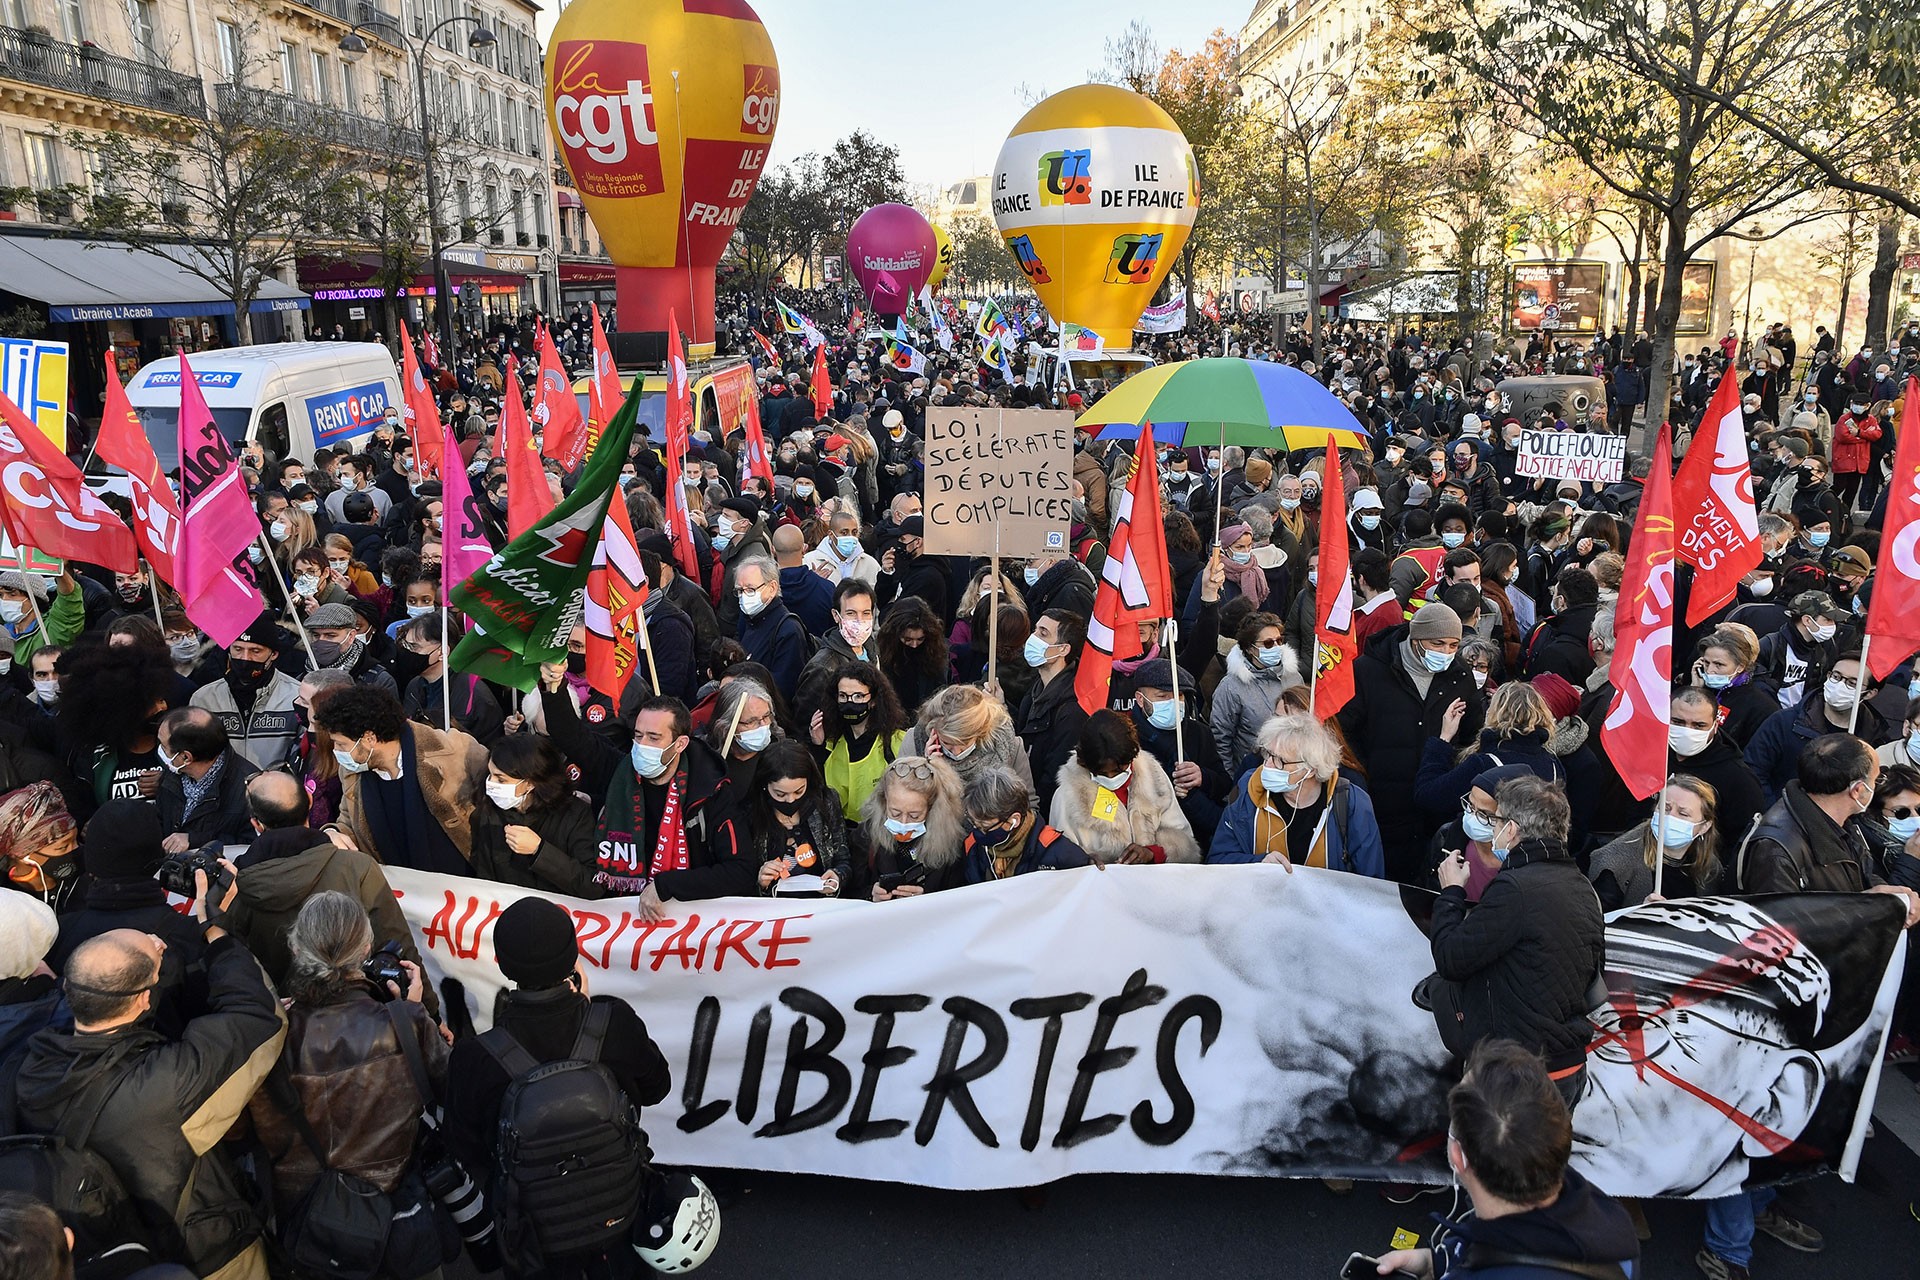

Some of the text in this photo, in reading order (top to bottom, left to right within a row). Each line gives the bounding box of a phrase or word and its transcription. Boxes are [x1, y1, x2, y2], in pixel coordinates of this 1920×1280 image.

[555, 80, 658, 164] cgt
[743, 90, 778, 134] cgt
[739, 150, 763, 170] ILE
[1135, 164, 1159, 182] ILE
[728, 179, 752, 198] DE
[1101, 189, 1185, 209] DE FRANCE
[864, 256, 921, 272] Solidaires
[314, 291, 327, 300] AU
[328, 289, 357, 300] ROYAL
[71, 306, 153, 320] Librairie L'Acacia
[271, 300, 299, 311] Librairie
[151, 373, 181, 384] REN
[202, 373, 233, 384] CAR
[314, 401, 348, 433] RENT
[360, 393, 384, 419] CAR
[929, 429, 1066, 467] SCÉLÉRATE
[934, 461, 1069, 492] DÉPUTÉS
[1566, 457, 1623, 483] AVEUGLE
[931, 495, 1071, 525] COMPLICES
[254, 714, 287, 729] adam
[599, 841, 638, 870] SNJ
[676, 967, 1223, 1153] LIBERTÉS
